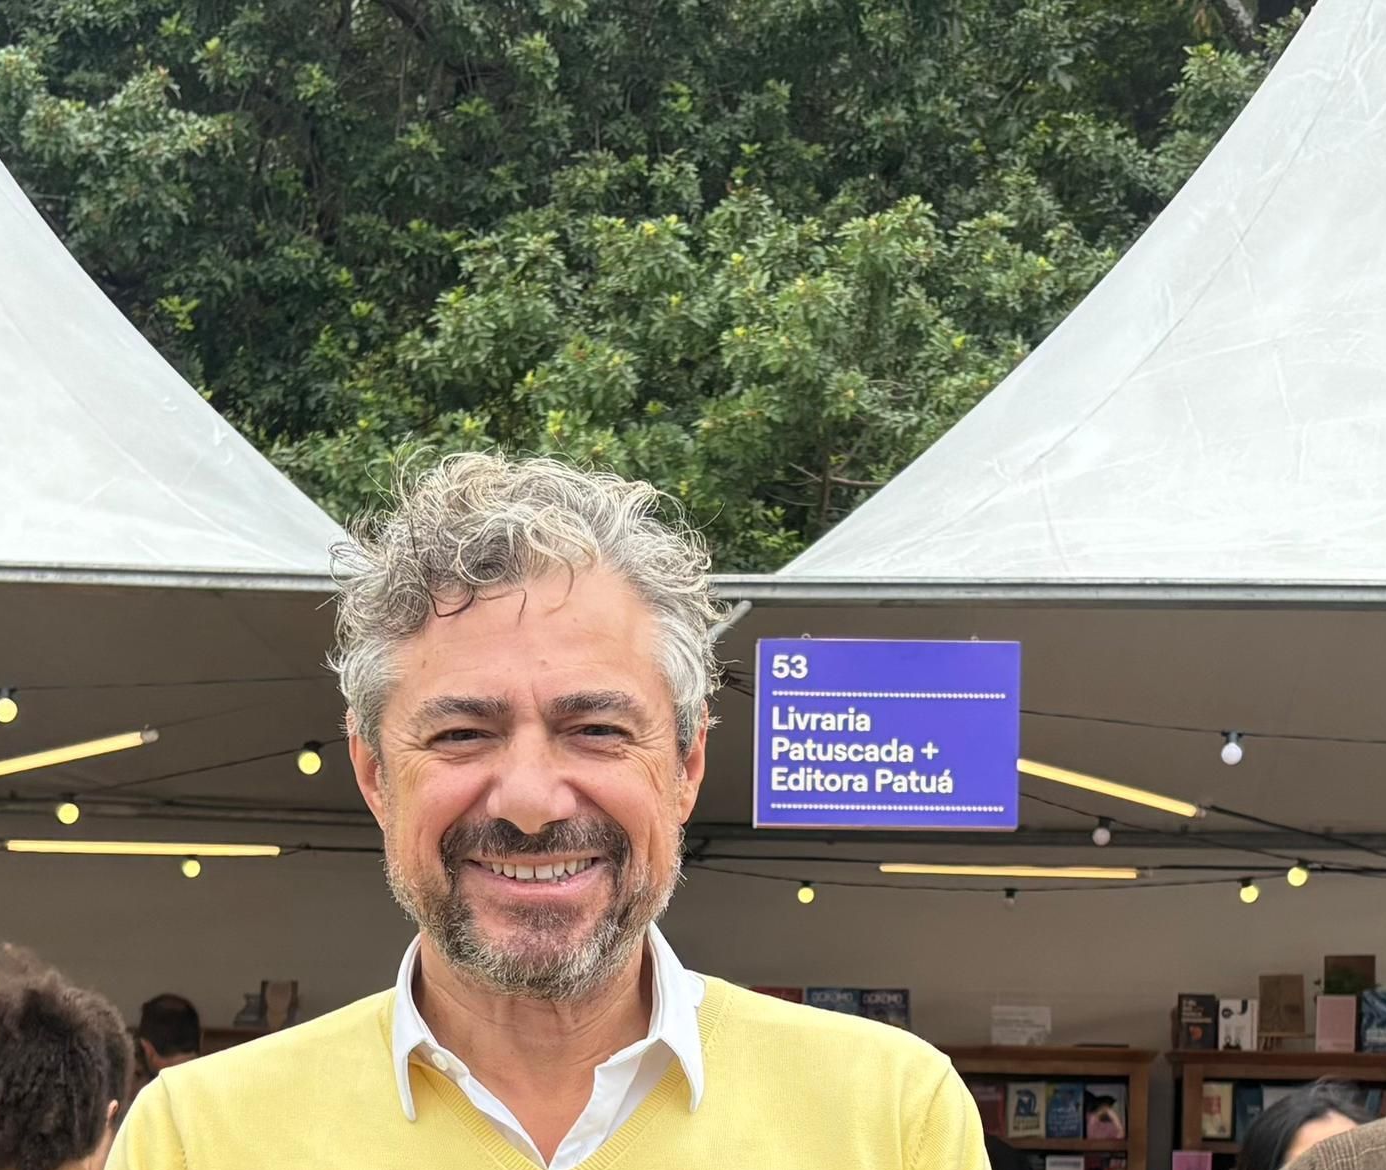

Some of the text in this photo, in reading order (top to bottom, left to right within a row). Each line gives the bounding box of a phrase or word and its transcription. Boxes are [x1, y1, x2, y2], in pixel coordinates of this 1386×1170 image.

[771, 654, 809, 679] 53
[771, 705, 872, 732] Livraria
[771, 736, 940, 763] Patuscada +
[770, 766, 954, 794] Editora Patuá
